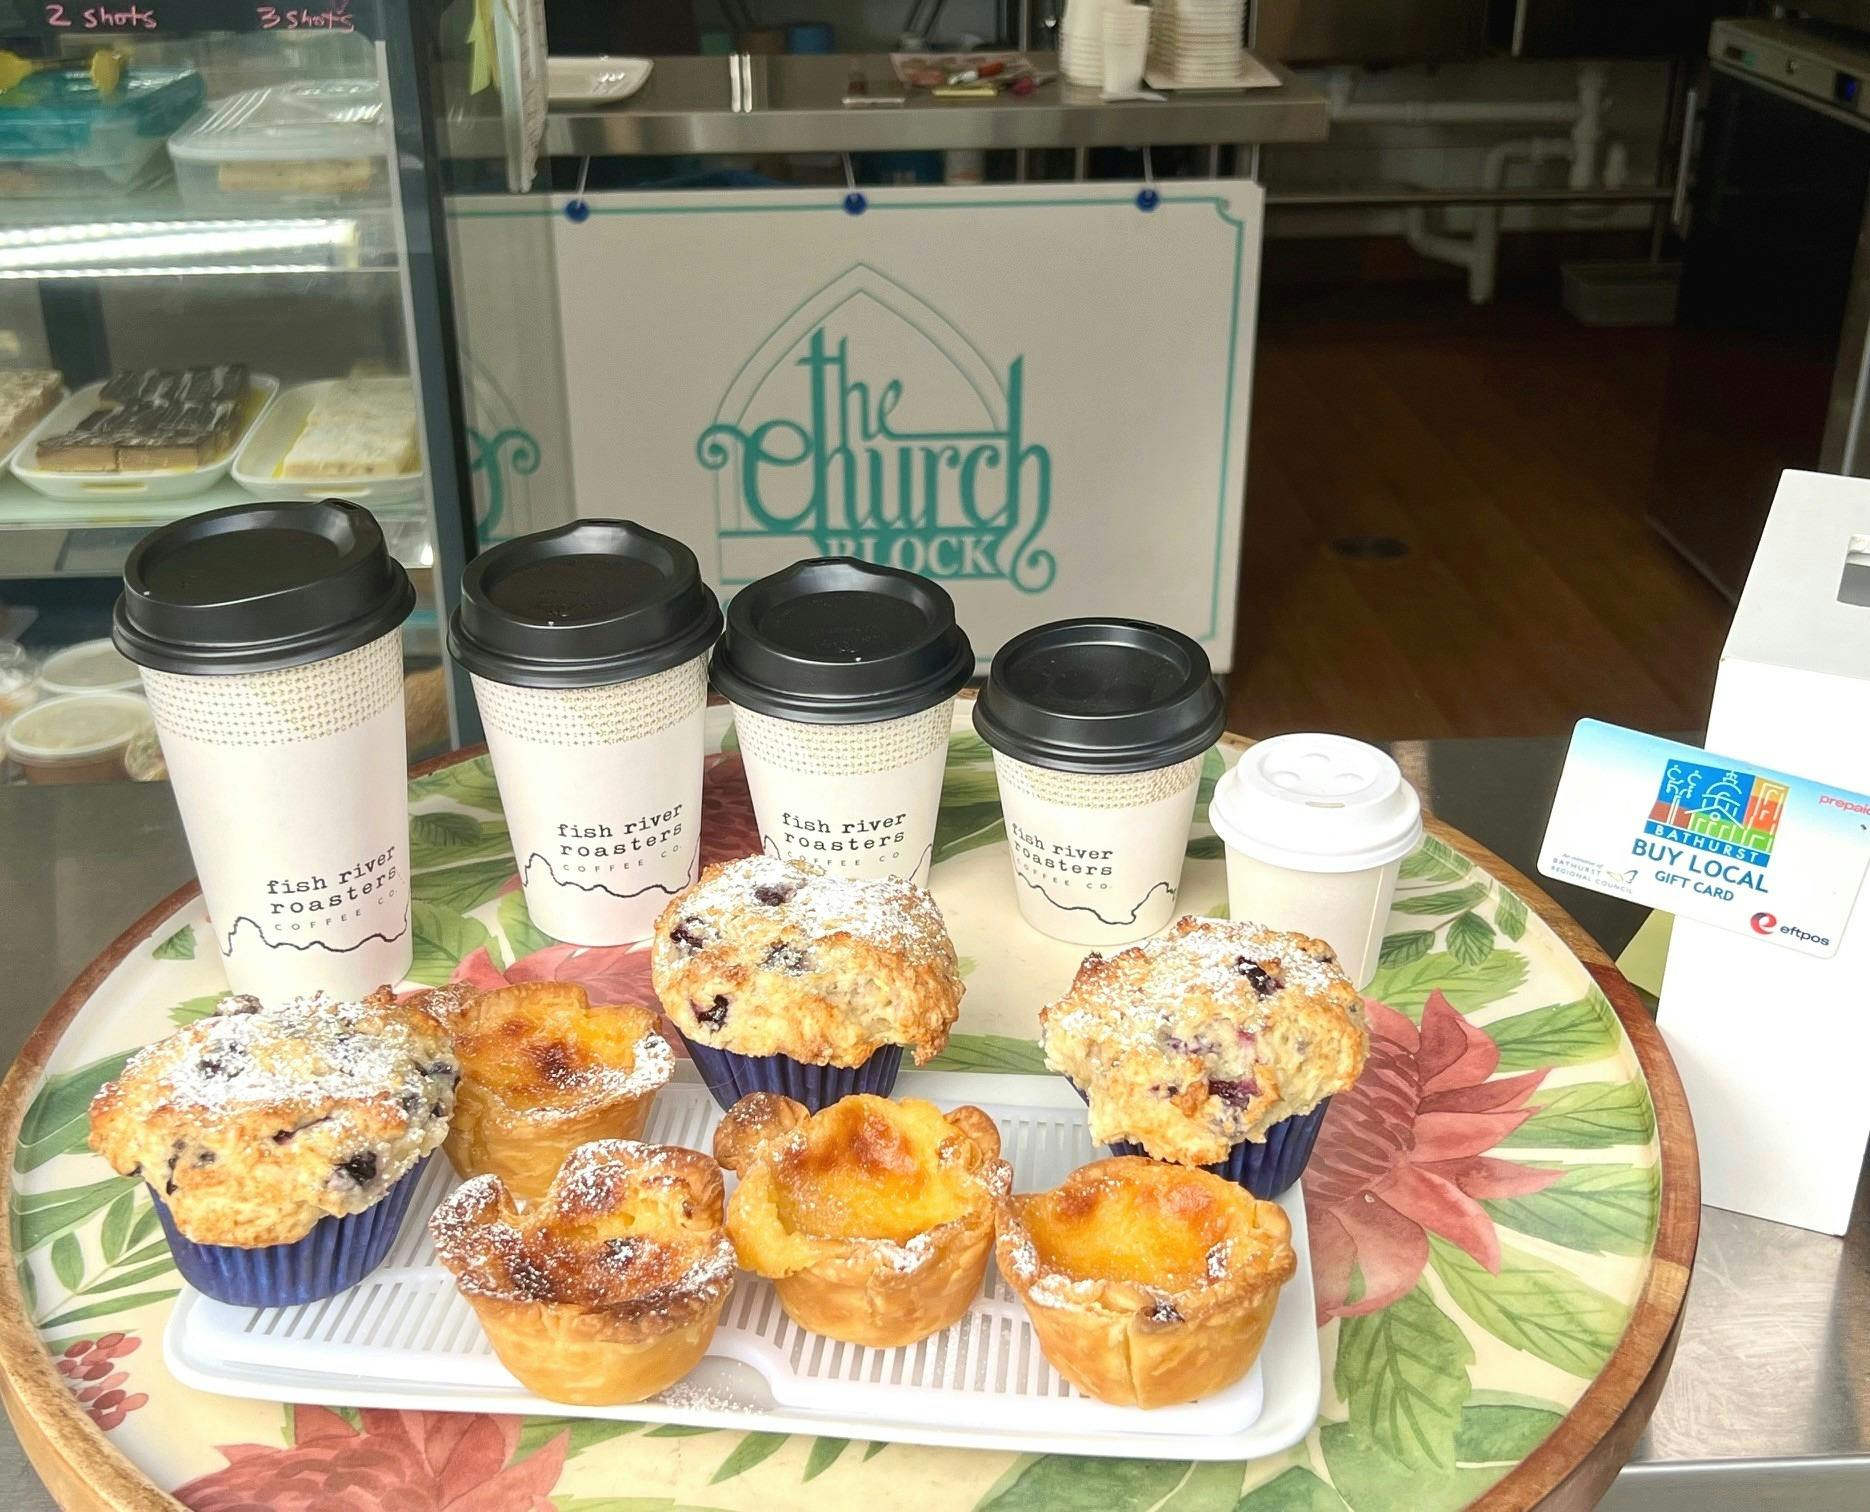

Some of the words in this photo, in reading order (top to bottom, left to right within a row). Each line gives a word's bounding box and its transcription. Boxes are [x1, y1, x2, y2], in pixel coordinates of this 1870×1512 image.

[46, 4, 72, 26] 2
[83, 6, 157, 29] shots
[257, 7, 280, 29] 3
[797, 327, 960, 441] the
[697, 354, 1057, 595] Church
[557, 824, 613, 838] fish
[624, 804, 683, 834] river
[782, 812, 831, 833] fish
[842, 813, 906, 833] river
[560, 823, 682, 857] roasters
[785, 832, 904, 851] roasters
[1012, 822, 1045, 850] fish
[1053, 845, 1113, 859] river
[1655, 825, 1759, 863] BATHURST
[267, 876, 327, 894] fish
[339, 846, 395, 884] river
[563, 859, 644, 872] COFFEE
[1015, 841, 1112, 875] roasters
[1553, 858, 1601, 875] BATHURST
[1632, 838, 1683, 866] BUY
[1689, 855, 1768, 893] LOCAL
[270, 866, 396, 914] roasters
[1551, 865, 1591, 882] REGIONAL
[1595, 879, 1632, 894] COUNCIL
[1655, 870, 1691, 888] GIFT
[1693, 882, 1734, 901] CARD
[275, 909, 361, 930] COFFEE
[1780, 925, 1830, 946] eftpos
